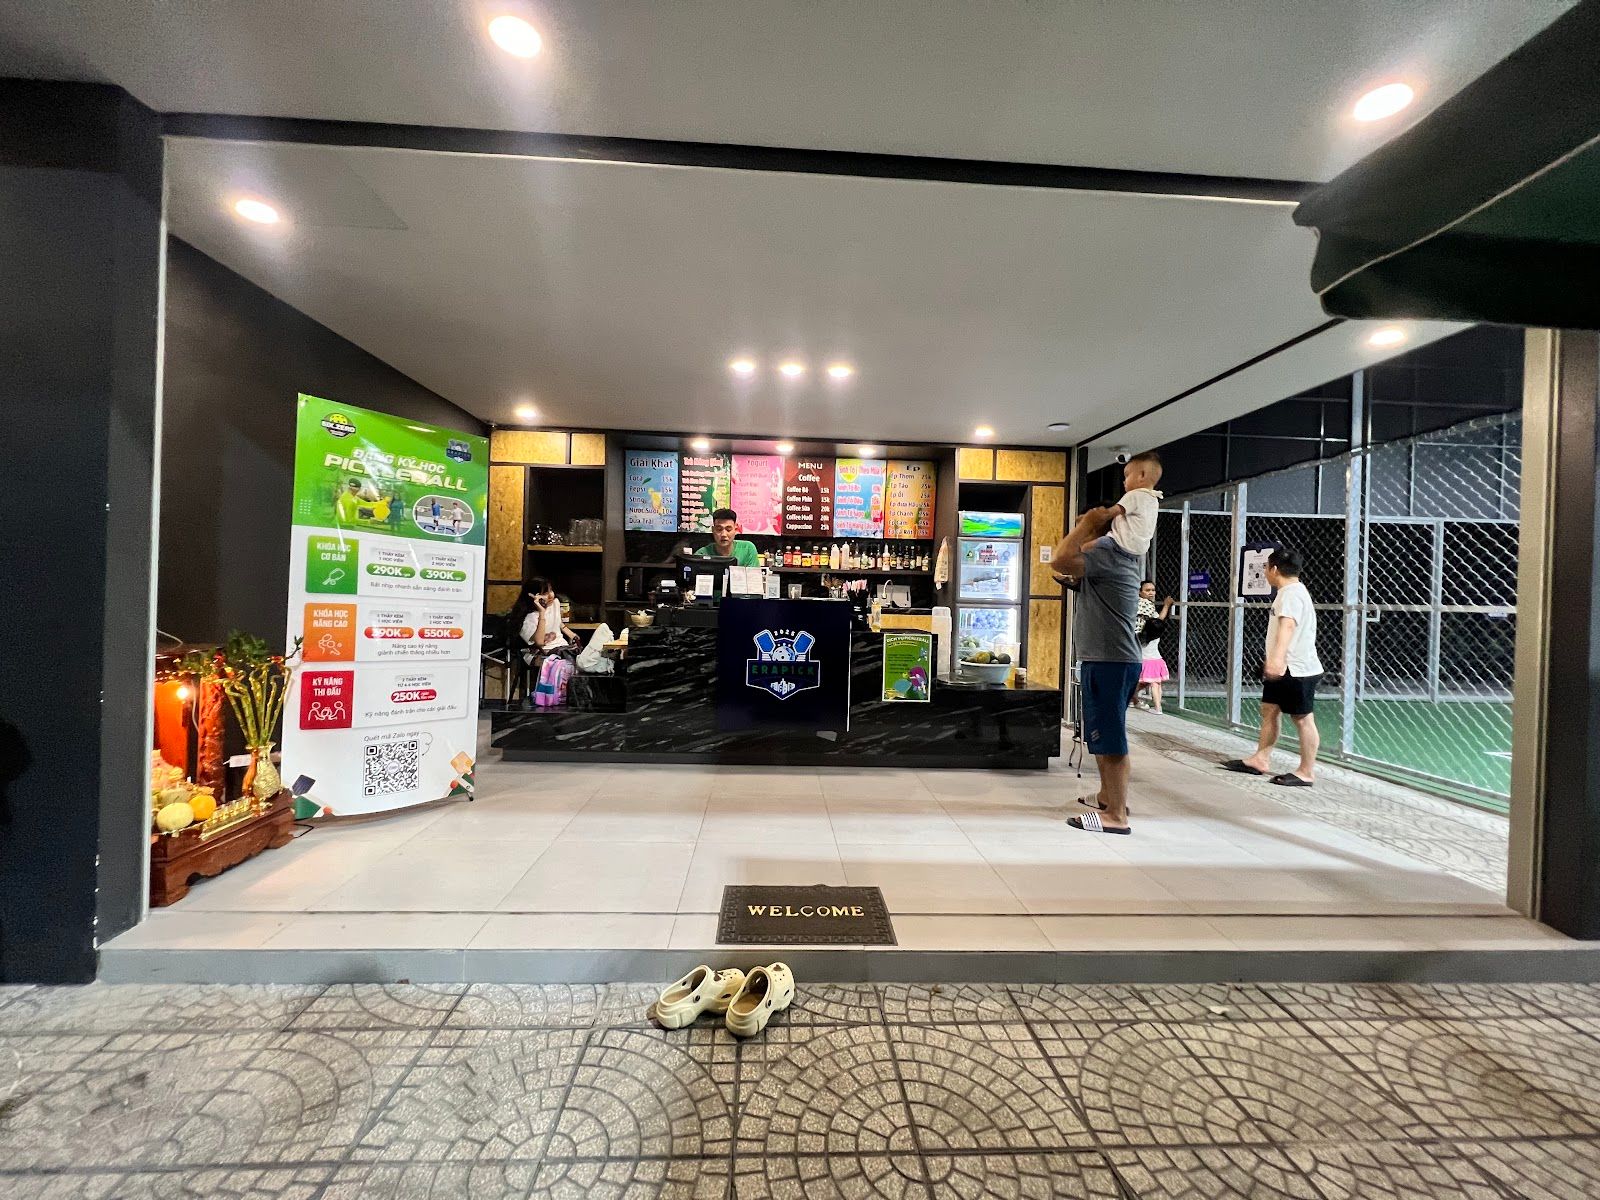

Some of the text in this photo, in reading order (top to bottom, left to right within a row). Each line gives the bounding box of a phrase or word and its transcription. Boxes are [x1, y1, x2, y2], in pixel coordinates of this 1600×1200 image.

[798, 462, 823, 470] MENU
[798, 474, 821, 482] Coffee
[785, 522, 813, 530] Cappuccino
[372, 565, 402, 576] 290K
[425, 569, 455, 580] 390K
[313, 608, 349, 619] KHÓA HỌC
[333, 619, 348, 628] CAO
[424, 628, 451, 638] 550K
[773, 629, 796, 637] 2025
[751, 664, 815, 675] ERAPICK
[312, 676, 343, 686] KỸ NĂNG
[314, 688, 326, 697] THI
[392, 691, 420, 702] 250K
[747, 905, 865, 917] WELCOME
